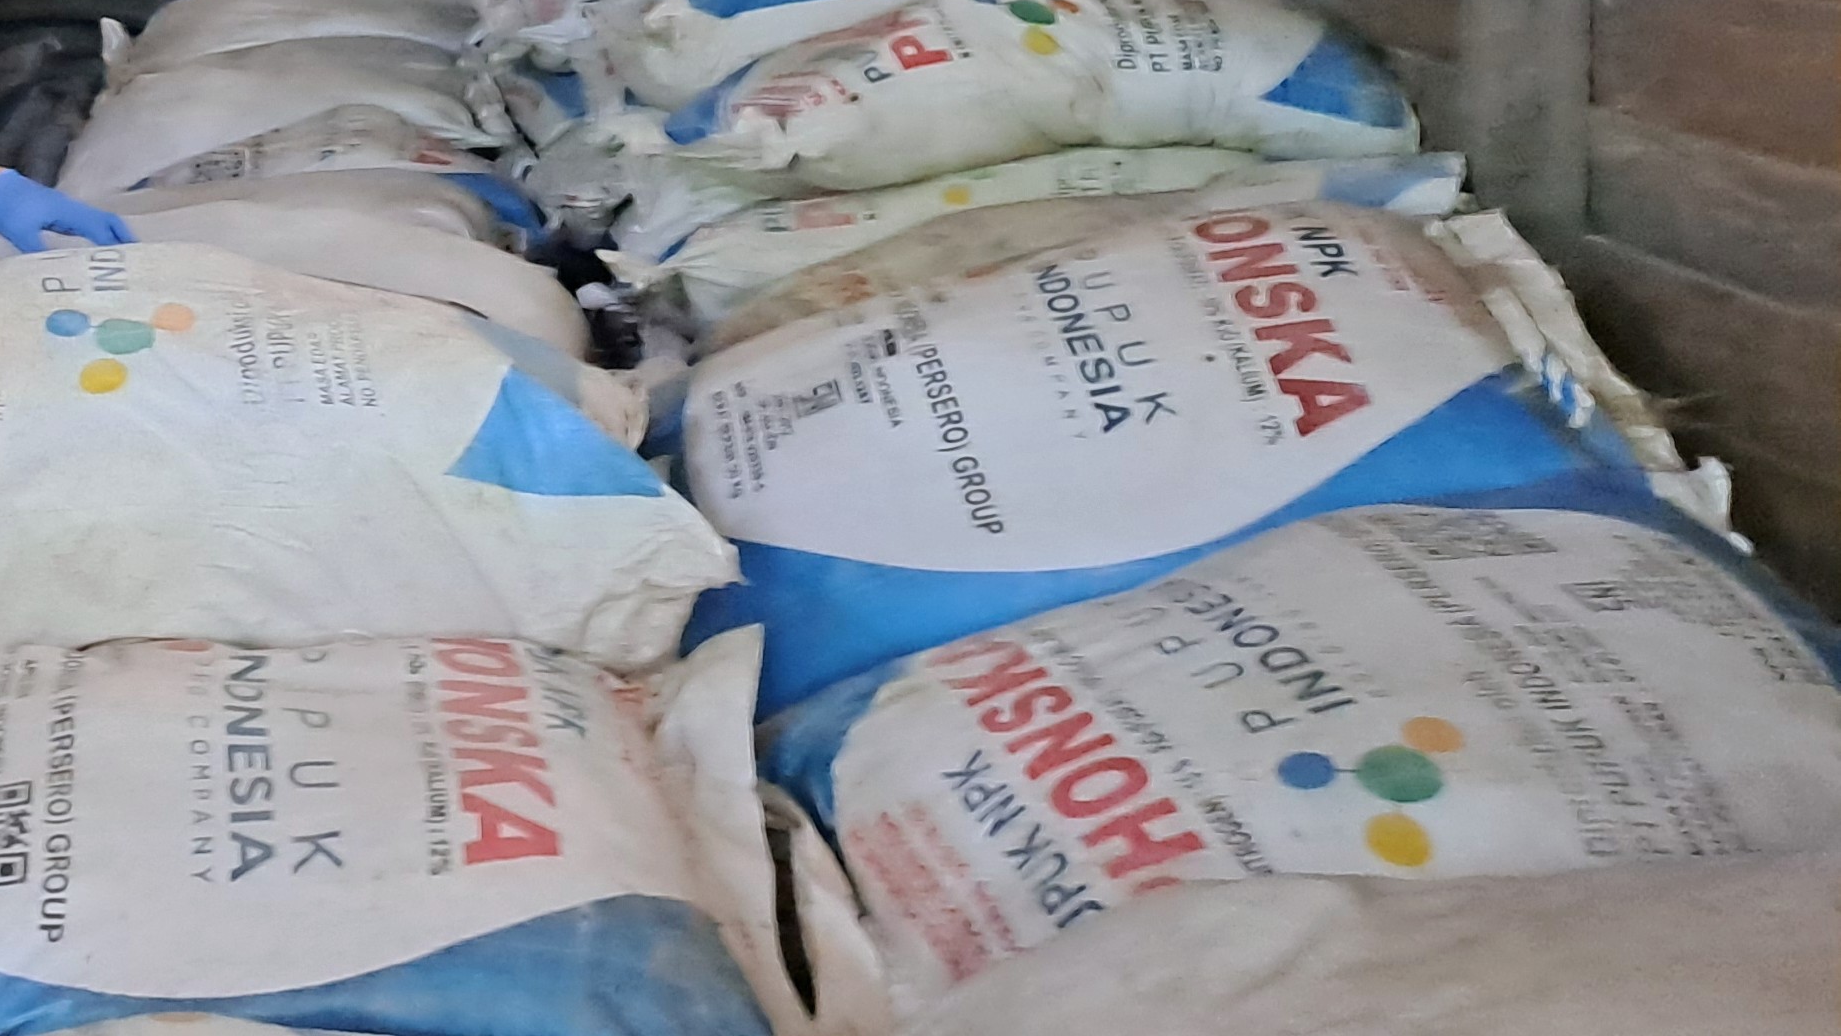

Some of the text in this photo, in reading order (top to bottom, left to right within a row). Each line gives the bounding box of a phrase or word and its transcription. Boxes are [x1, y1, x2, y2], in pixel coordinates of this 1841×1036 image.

[1291, 225, 1359, 278] NPK
[910, 340, 1005, 535] (PERSERO) GROUP
[43, 693, 81, 825] (PERSERO)
[940, 749, 1028, 838] NPK
[38, 832, 73, 944] GROUP
